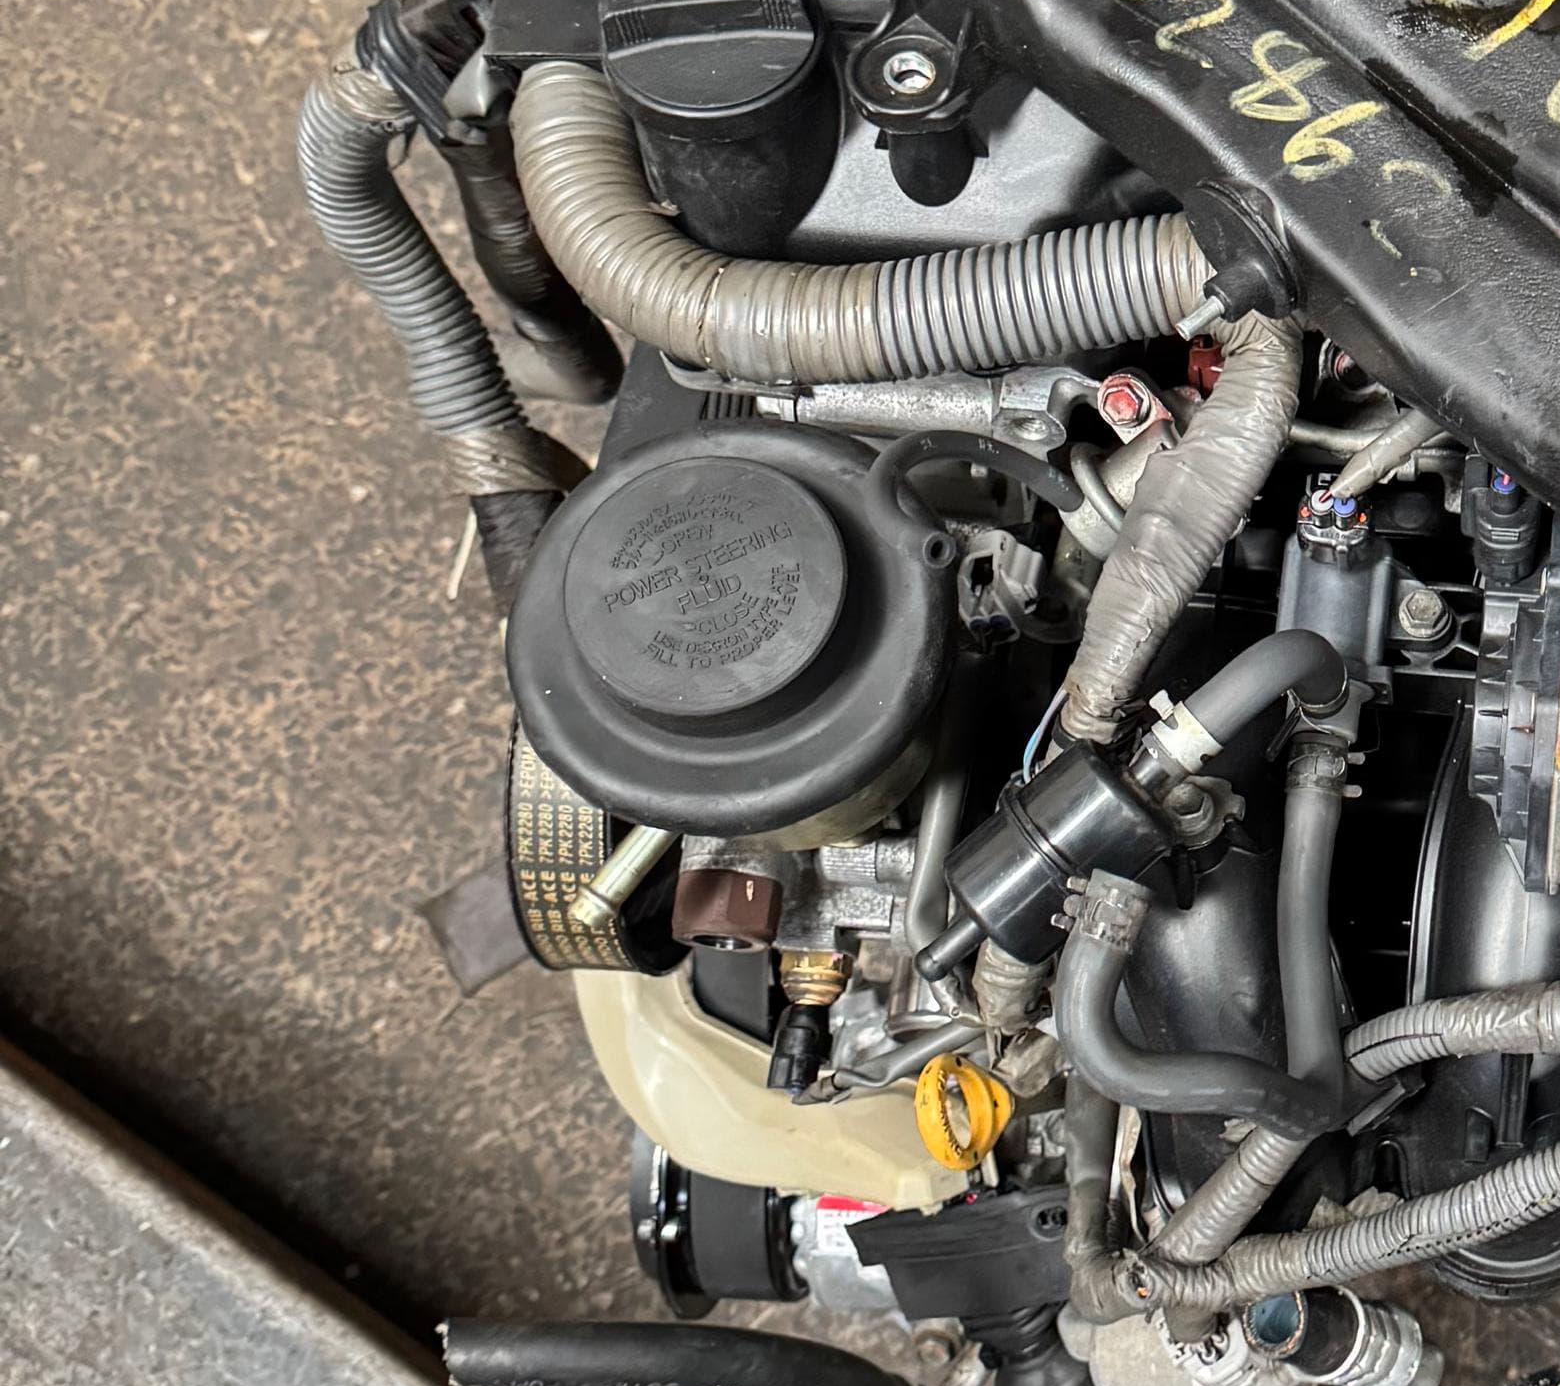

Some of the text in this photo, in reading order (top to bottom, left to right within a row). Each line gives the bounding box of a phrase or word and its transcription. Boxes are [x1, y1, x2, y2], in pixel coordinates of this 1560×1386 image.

[662, 524, 713, 555] OPEN
[604, 564, 682, 613] POWER
[685, 521, 793, 574] STEERING
[676, 574, 742, 615] FLUID
[690, 656, 712, 669] TO
[719, 621, 783, 665] PROPER
[778, 562, 801, 616] LEVEL
[698, 591, 760, 635] CLOSE
